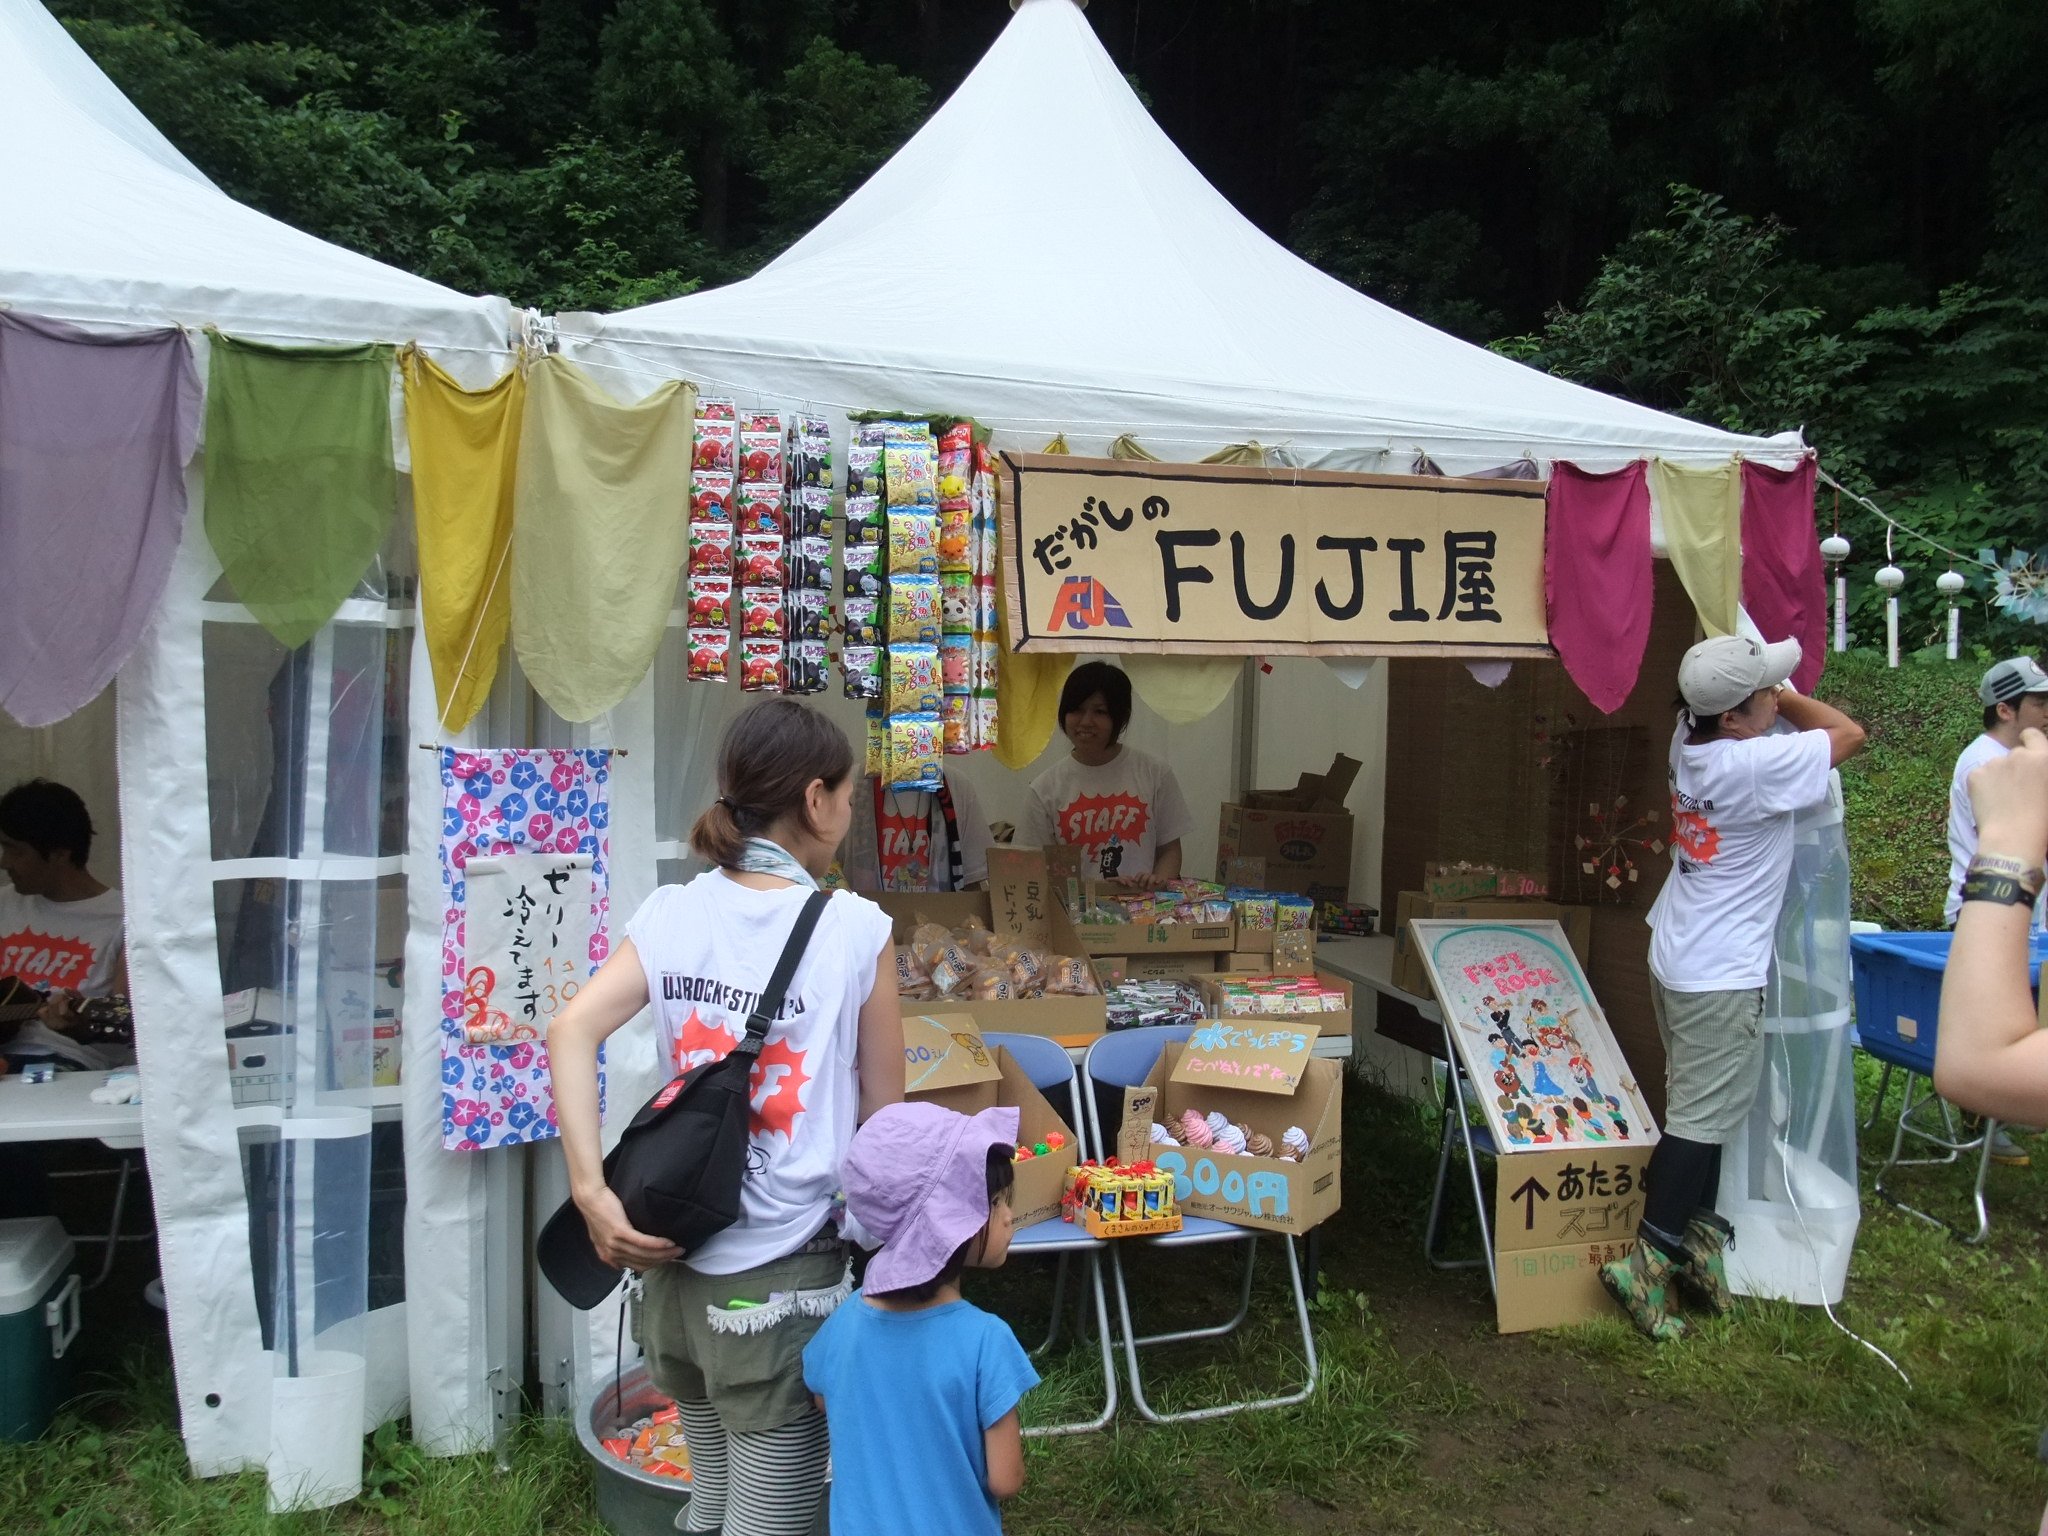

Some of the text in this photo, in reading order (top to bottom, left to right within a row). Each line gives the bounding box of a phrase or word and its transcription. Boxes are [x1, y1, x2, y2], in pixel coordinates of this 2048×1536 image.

[1032, 495, 1170, 576] だがしの
[1155, 527, 1503, 624] FUJI屋
[1069, 804, 1141, 841] STAFF
[882, 827, 931, 857] TAF
[543, 863, 576, 949] ゼリー
[1025, 881, 1043, 921] 豆乳
[1991, 880, 2013, 899] 10
[1003, 885, 1022, 933] ドーナツ
[1, 945, 85, 979] STAFF
[502, 884, 541, 1022] 冷えてます
[542, 981, 580, 1014] 30
[1493, 968, 1560, 996] ROCK
[1189, 1022, 1308, 1053] 水でっぽう
[1132, 1096, 1151, 1112] 500
[1155, 1151, 1291, 1217] 300円
[1557, 1199, 1640, 1240] スゴイ
